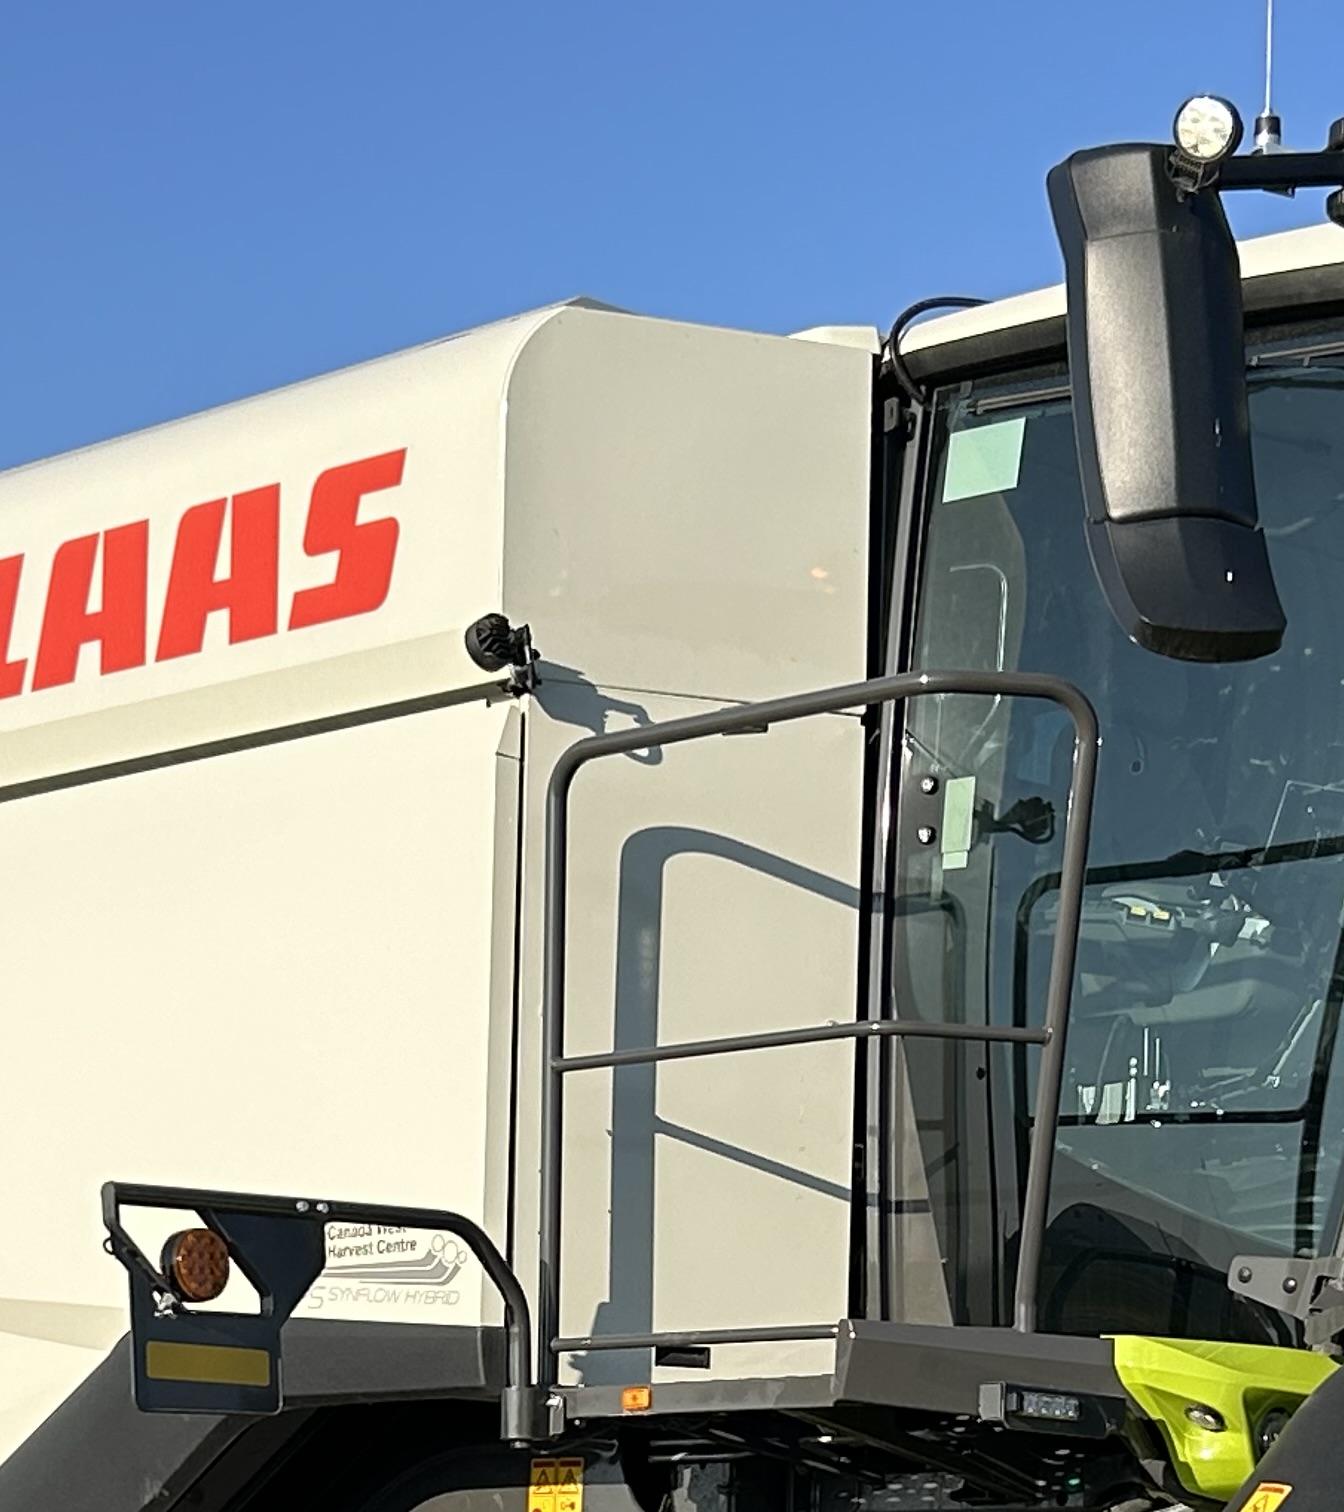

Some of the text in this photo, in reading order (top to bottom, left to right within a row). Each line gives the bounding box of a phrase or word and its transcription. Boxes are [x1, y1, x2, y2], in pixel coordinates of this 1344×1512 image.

[328, 1224, 373, 1241] Canada
[328, 1238, 418, 1259] Harvest Centre
[328, 1286, 402, 1304] SYNFLOW
[402, 1289, 461, 1306] HYBRID
